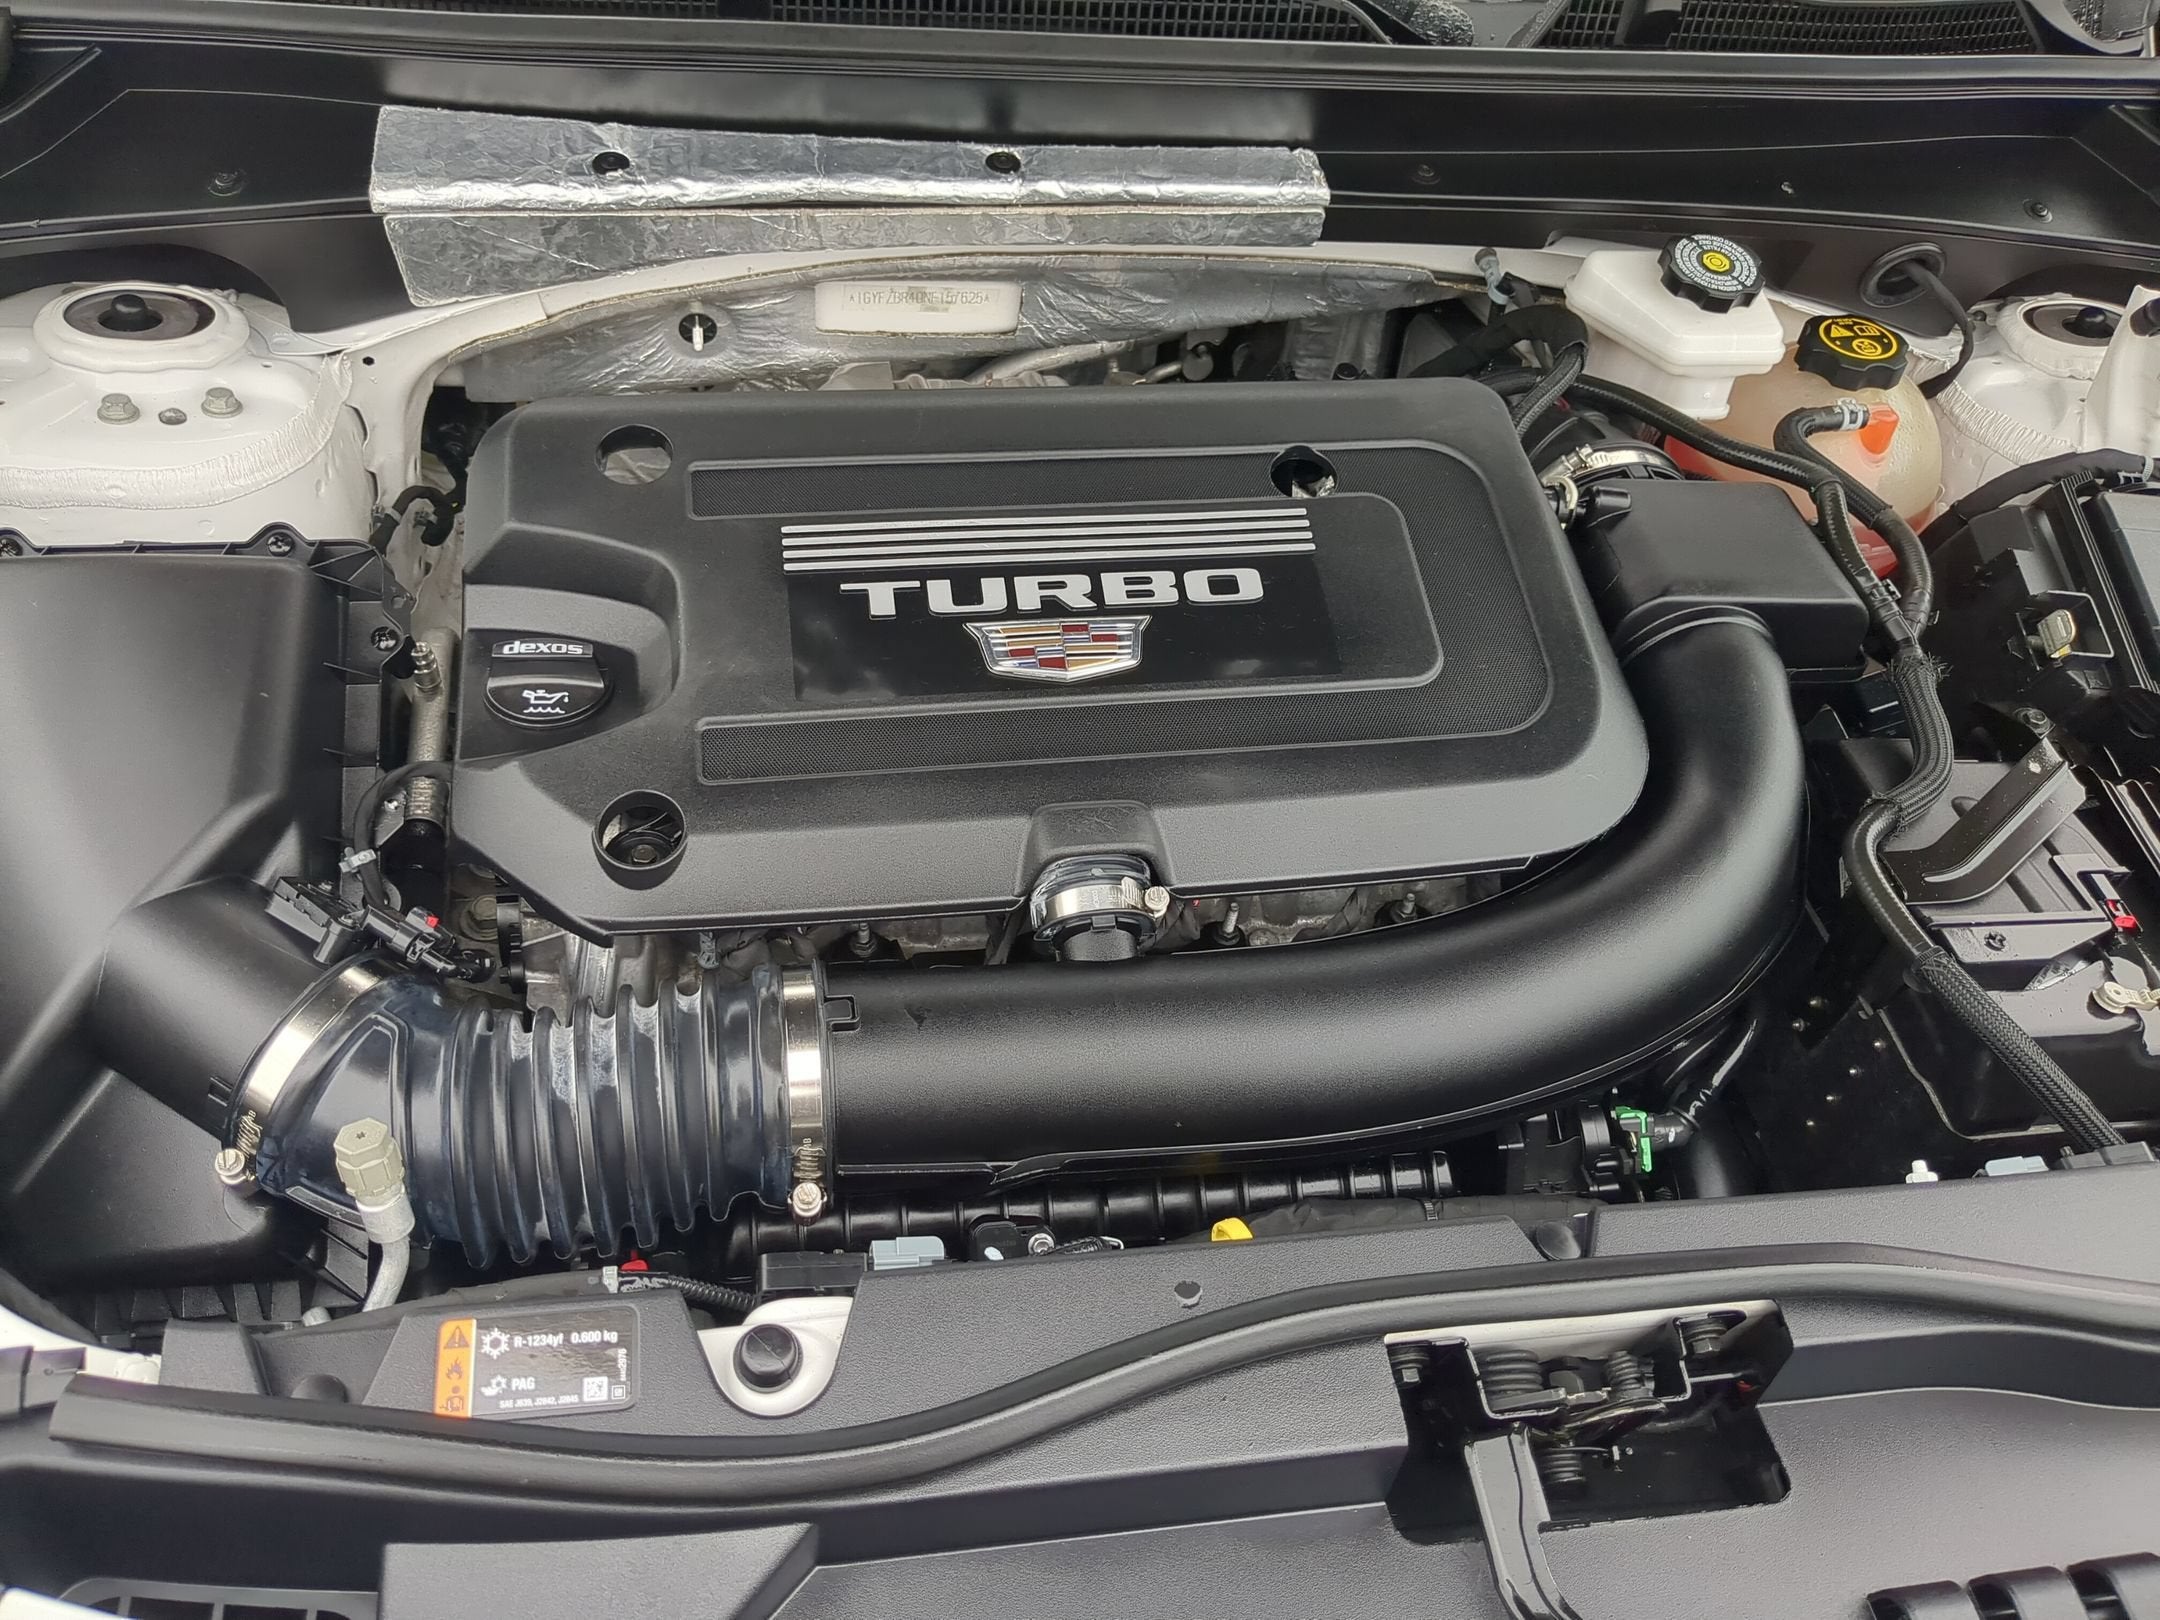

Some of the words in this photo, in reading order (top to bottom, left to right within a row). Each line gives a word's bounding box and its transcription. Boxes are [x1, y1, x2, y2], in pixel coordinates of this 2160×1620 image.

[839, 568, 1264, 619] TURBO
[502, 640, 583, 655] dexos
[514, 1333, 564, 1347] R-1234yf
[571, 1331, 602, 1343] 0.600
[603, 1330, 618, 1343] kg
[511, 1377, 536, 1391] PAG
[499, 1399, 514, 1409] SAE
